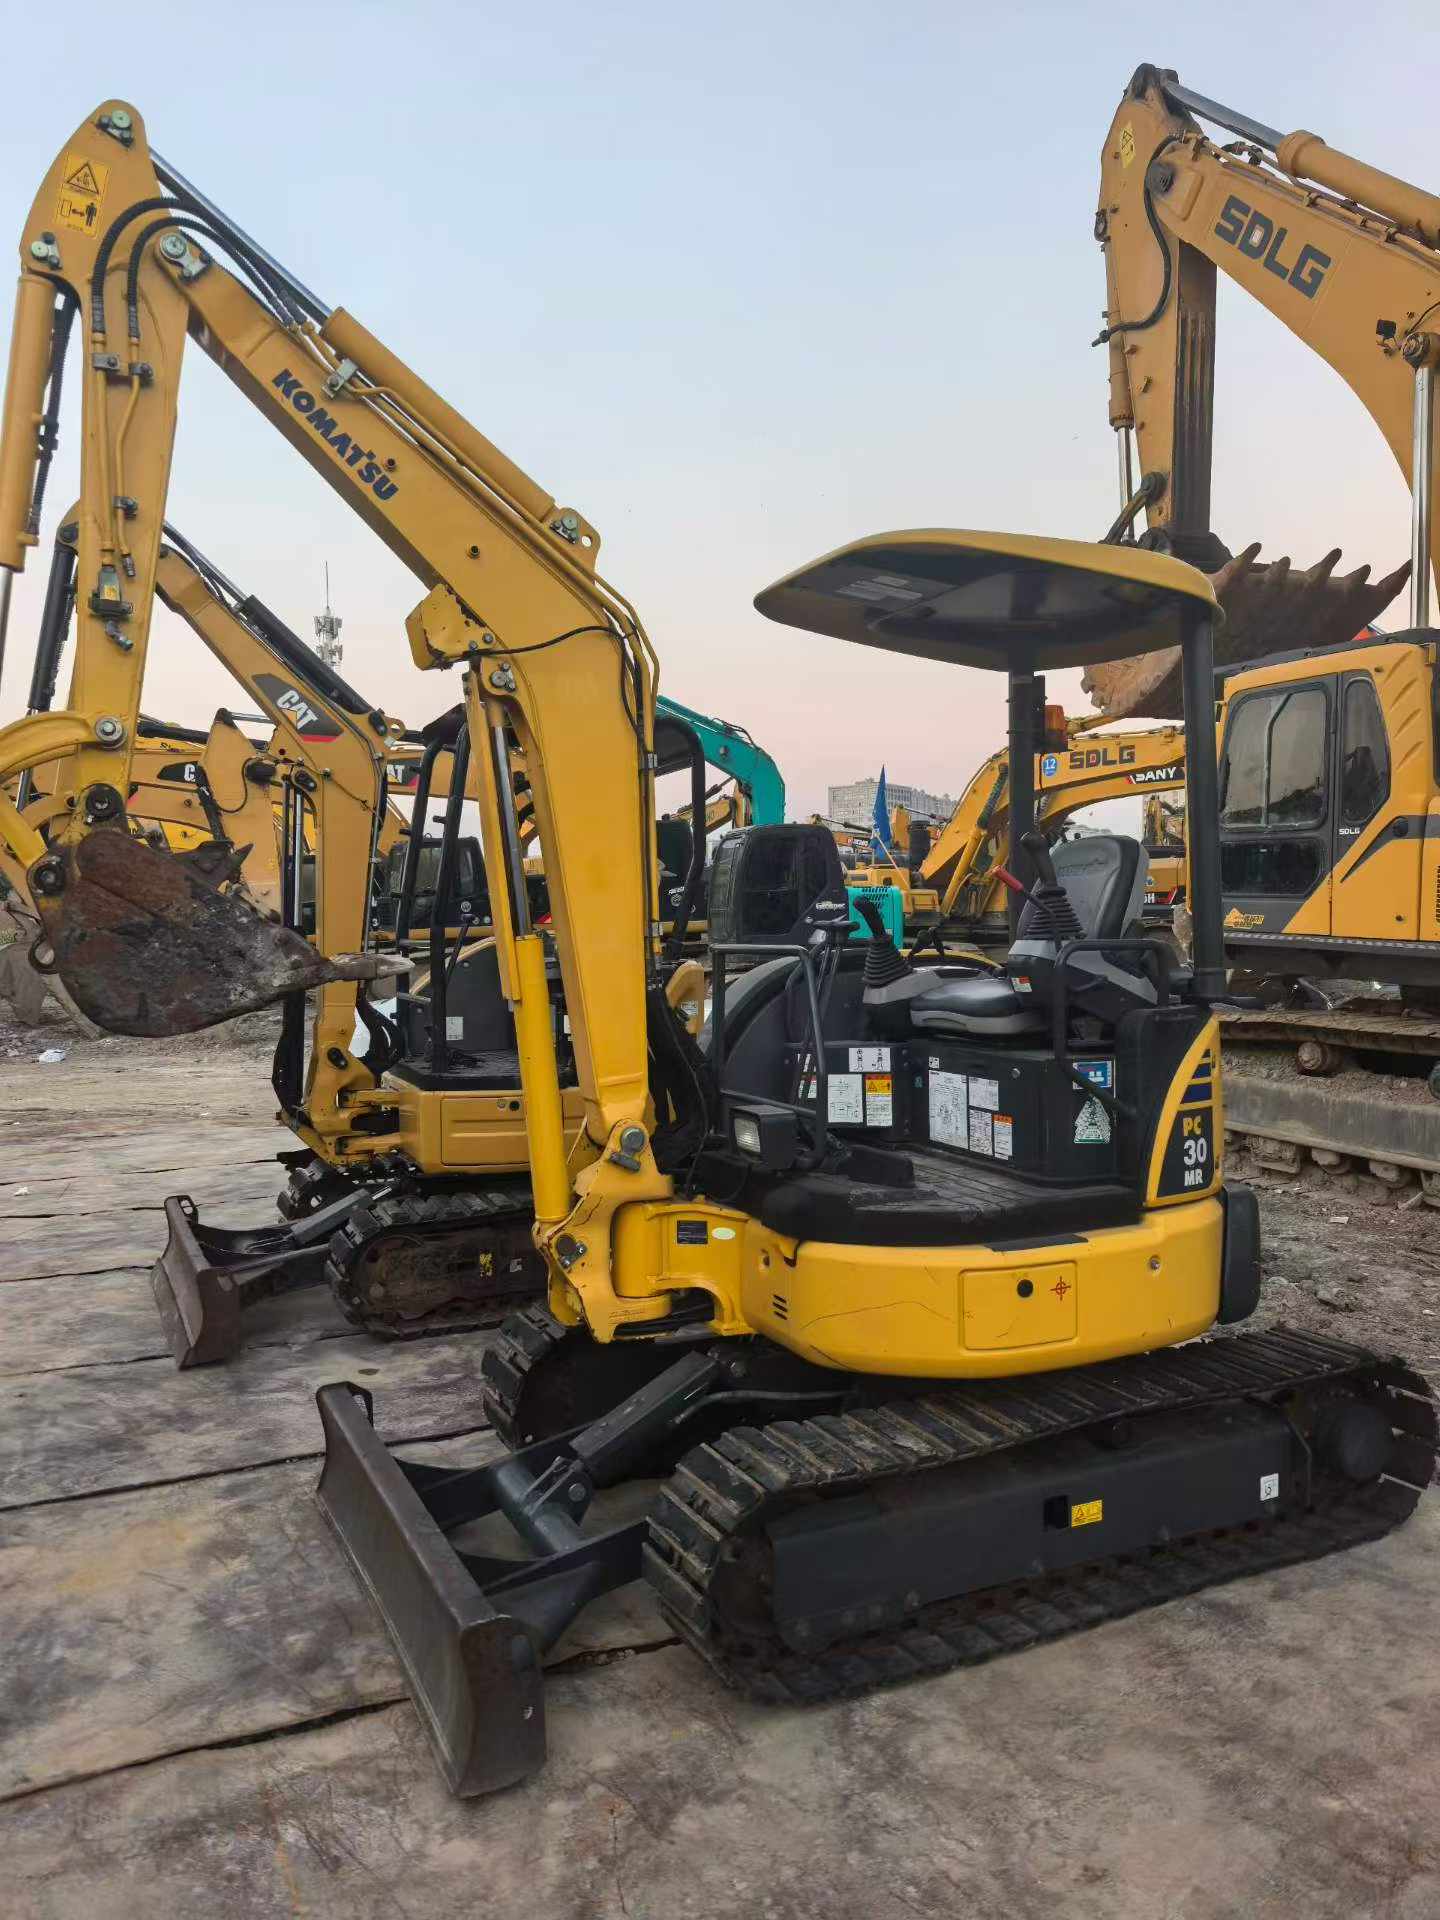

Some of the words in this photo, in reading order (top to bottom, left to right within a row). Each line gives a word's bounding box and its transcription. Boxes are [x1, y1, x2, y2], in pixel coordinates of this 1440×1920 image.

[1214, 194, 1332, 299] SDLG
[271, 367, 399, 501] KOMATSU
[277, 689, 319, 731] CAT
[1069, 744, 1136, 770] SDLG
[386, 764, 404, 784] AT
[1134, 766, 1177, 783] SANY
[1338, 827, 1361, 835] SDLG
[1182, 1115, 1202, 1137] PC
[1183, 1137, 1207, 1166] 30
[1184, 1168, 1203, 1187] MR
